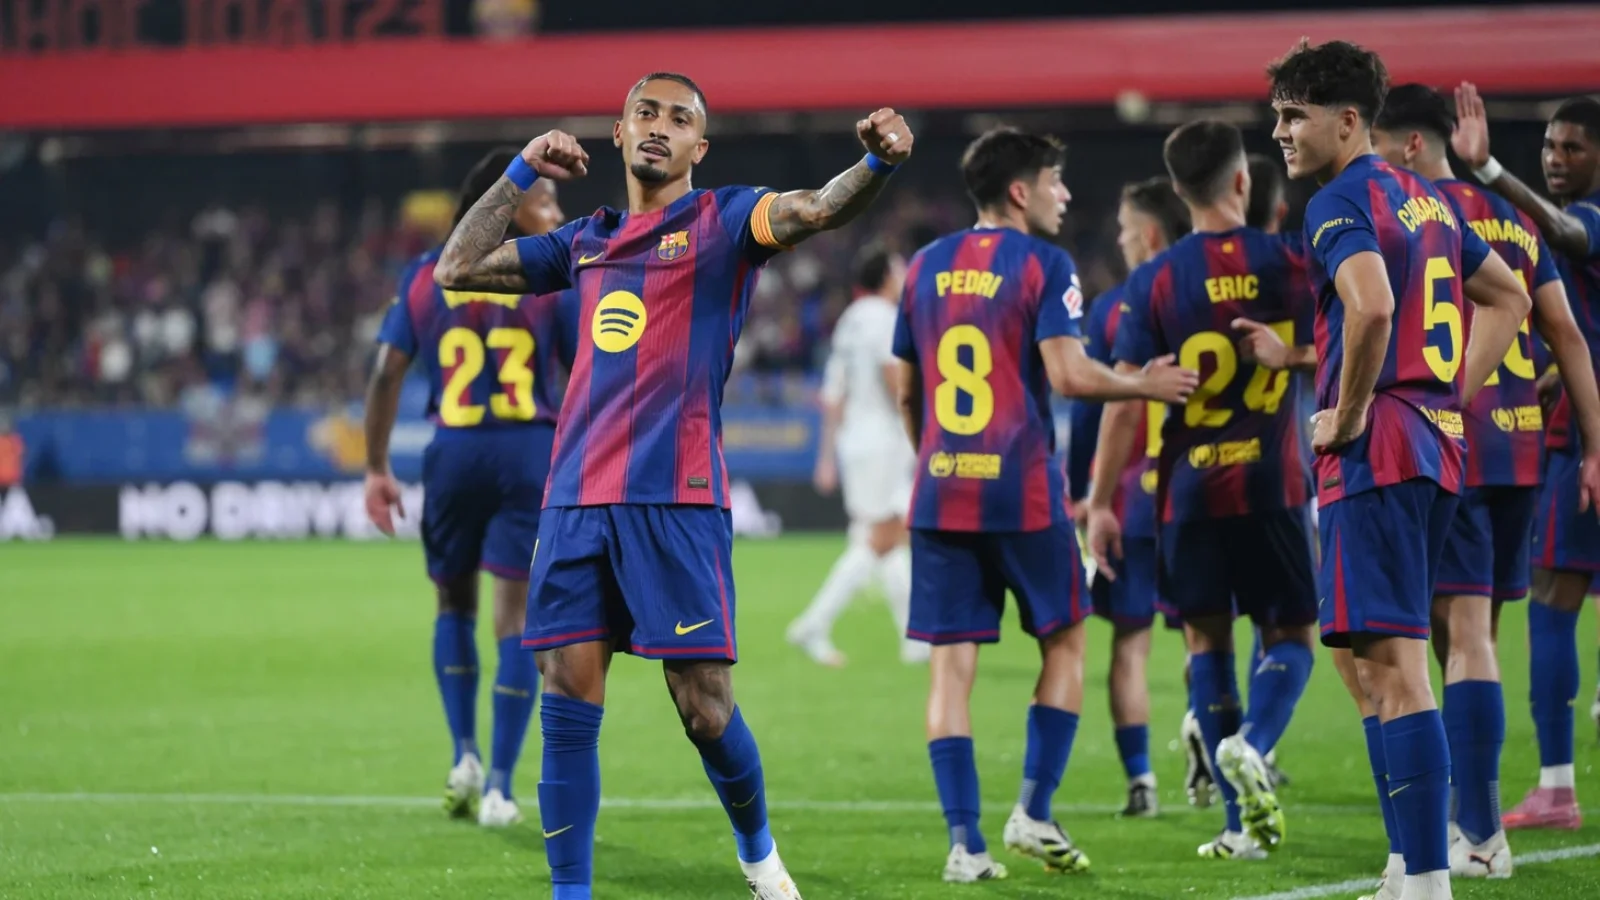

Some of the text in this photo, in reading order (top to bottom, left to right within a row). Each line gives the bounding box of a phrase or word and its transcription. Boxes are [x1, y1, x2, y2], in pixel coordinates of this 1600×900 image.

[936, 269, 1003, 299] PEDRI
[1205, 274, 1259, 303] ERIC
[1422, 256, 1463, 383] 5
[438, 327, 537, 427] 23
[935, 324, 994, 436] 8
[1179, 320, 1294, 427] 24
